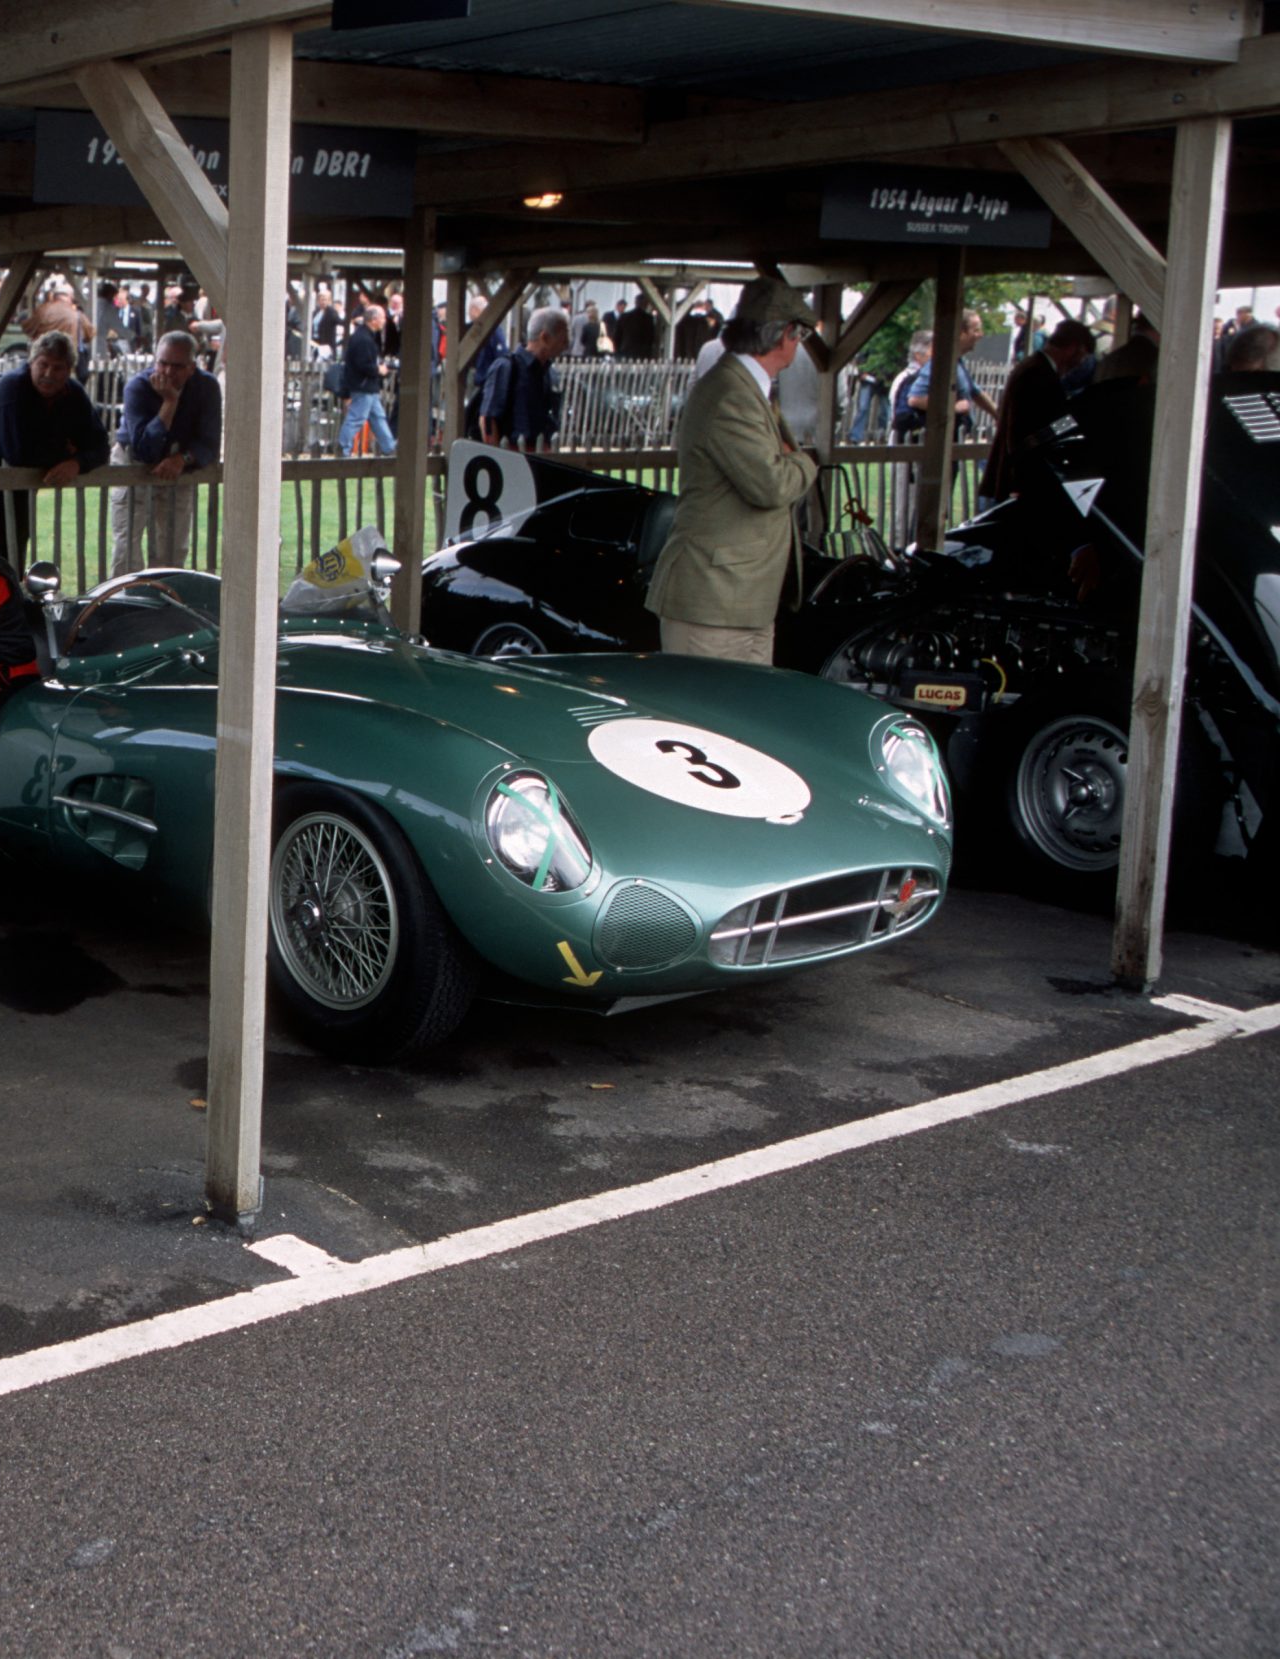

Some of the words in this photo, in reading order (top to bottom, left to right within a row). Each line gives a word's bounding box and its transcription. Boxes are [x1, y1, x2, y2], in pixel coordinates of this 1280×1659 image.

[312, 149, 371, 178] DBR1
[870, 188, 908, 210] 1954
[910, 189, 959, 218] Jaguar
[962, 192, 1009, 221] D-type
[906, 222, 936, 233] SUSSEX
[938, 223, 970, 234] TROPHY
[459, 455, 504, 540] 8
[918, 688, 962, 701] LUCAS
[655, 740, 741, 789] 3
